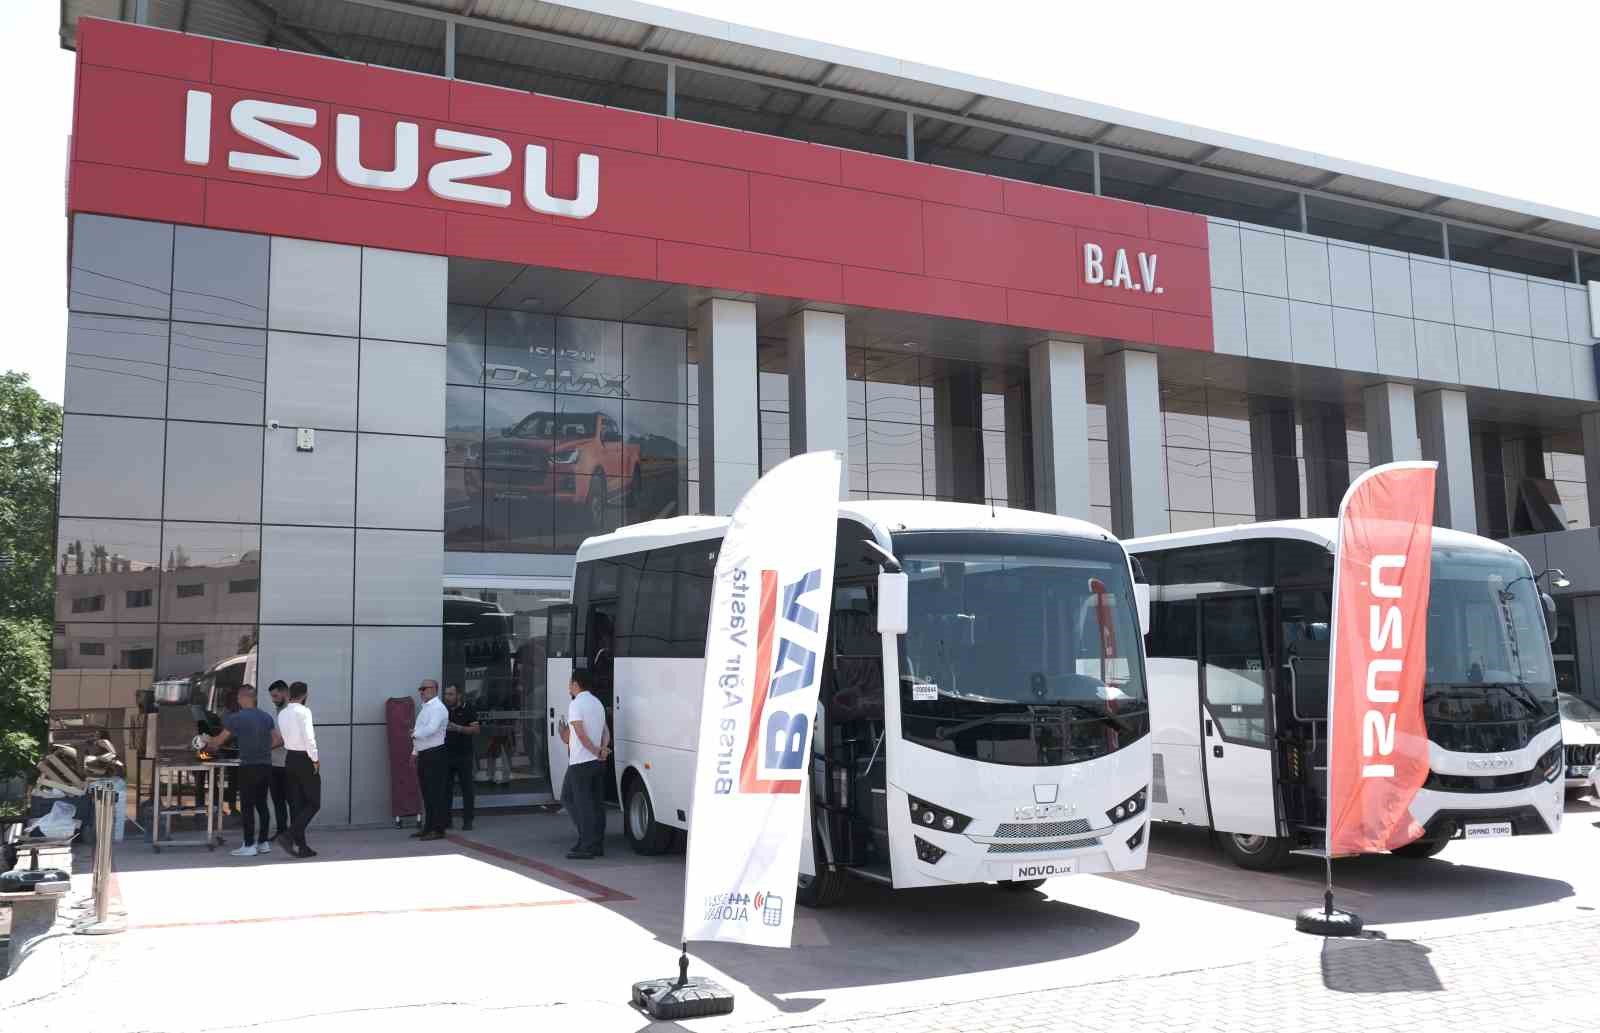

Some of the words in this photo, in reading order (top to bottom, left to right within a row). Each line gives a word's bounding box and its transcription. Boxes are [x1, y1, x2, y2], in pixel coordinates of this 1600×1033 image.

[184, 89, 600, 220] ISUZU
[1083, 242, 1165, 294] B.A.V.
[528, 344, 597, 362] ISUZU
[479, 361, 632, 398] D-MAX
